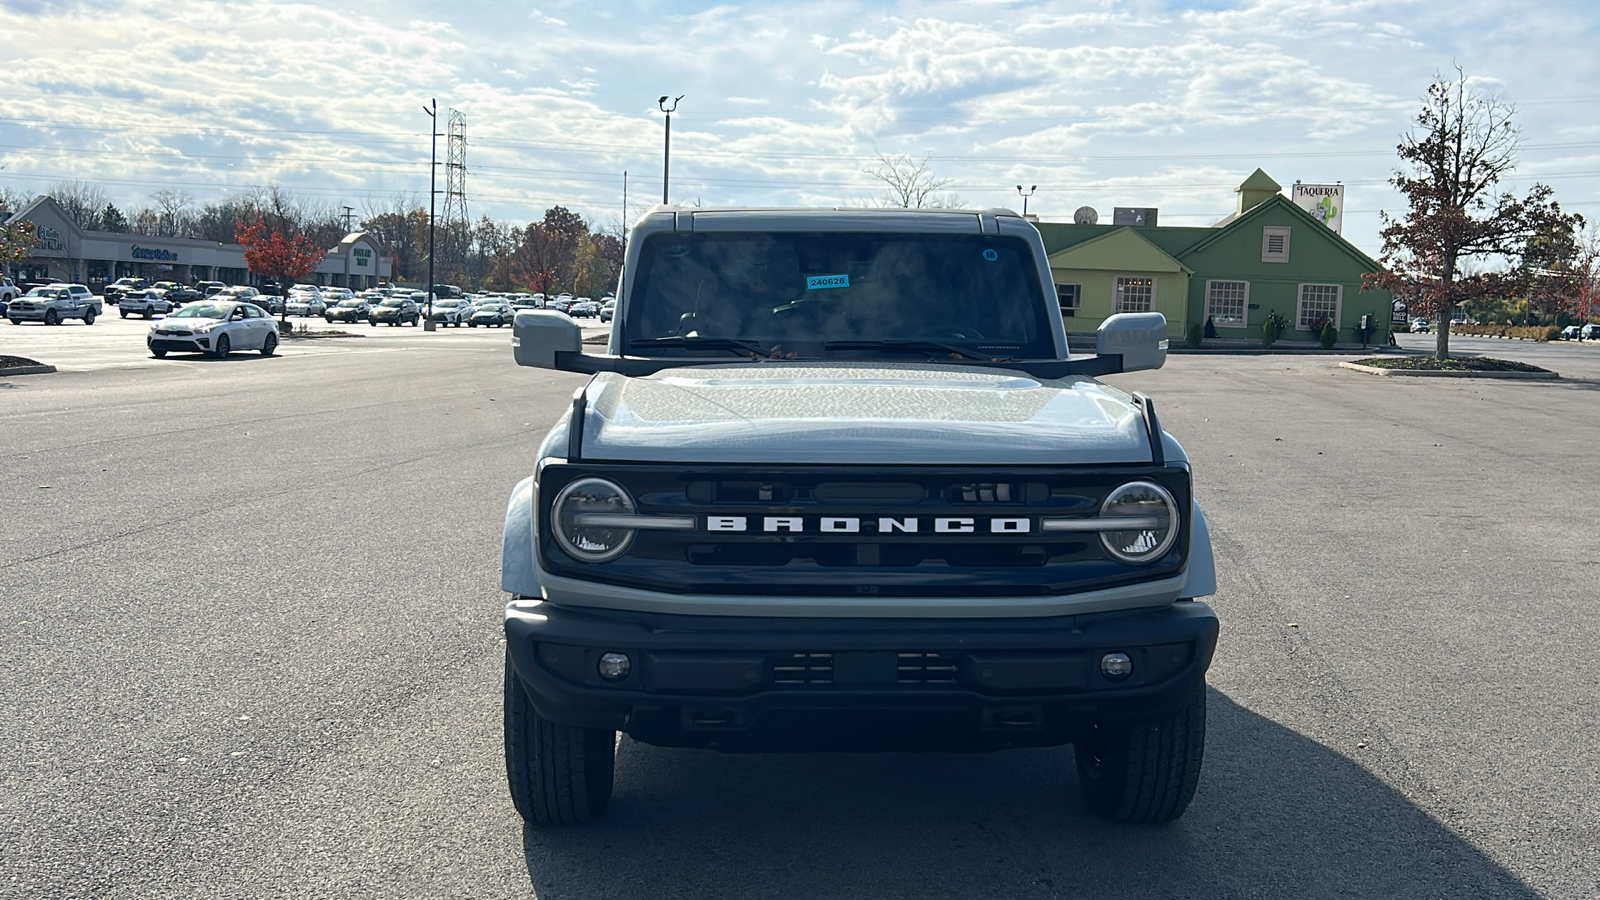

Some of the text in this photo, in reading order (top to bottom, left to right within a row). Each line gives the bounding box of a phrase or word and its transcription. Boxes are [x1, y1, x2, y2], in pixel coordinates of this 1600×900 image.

[1297, 186, 1338, 197] TAQUERIA
[810, 278, 845, 286] 240626
[707, 516, 1030, 533] BRONCO
